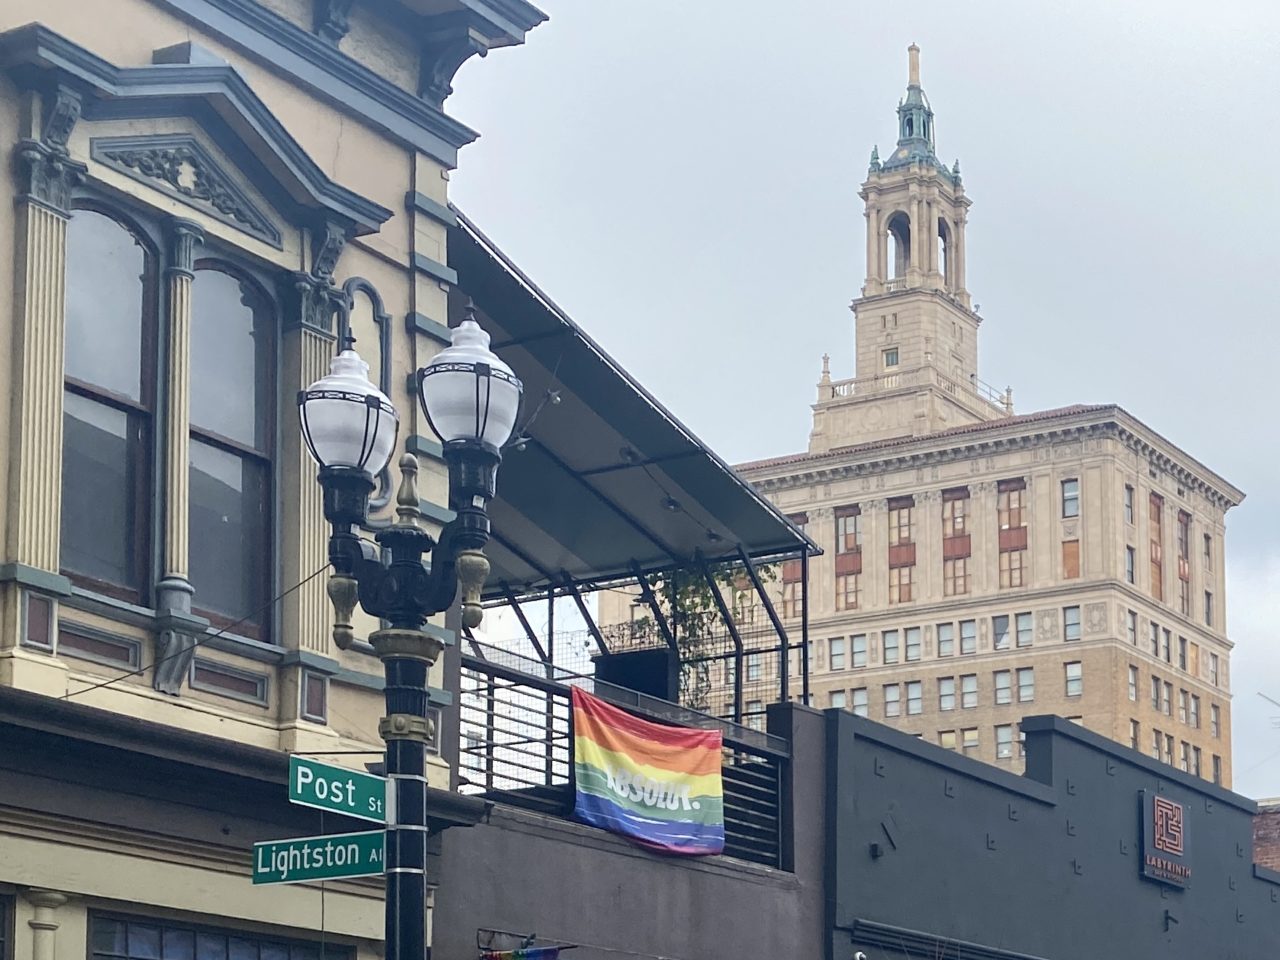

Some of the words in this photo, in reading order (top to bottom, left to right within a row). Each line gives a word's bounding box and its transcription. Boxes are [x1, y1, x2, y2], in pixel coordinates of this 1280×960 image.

[297, 766, 356, 806] Post
[368, 796, 382, 813] St
[257, 841, 359, 880] Lightston
[369, 848, 382, 862] Al
[1146, 854, 1191, 878] LABYRINTH
